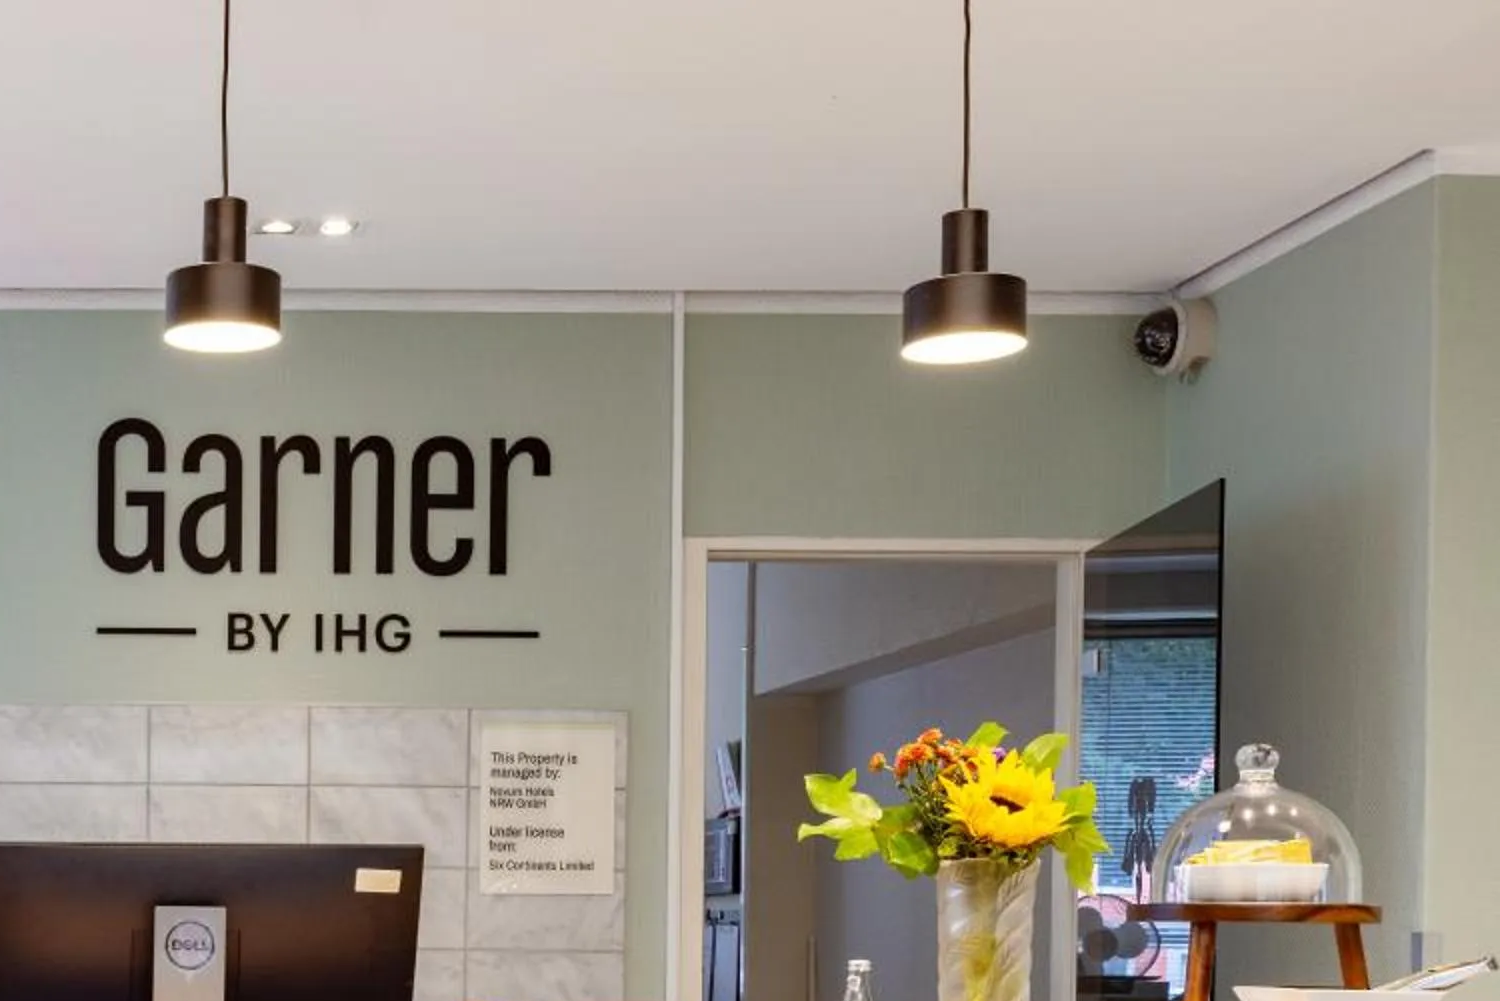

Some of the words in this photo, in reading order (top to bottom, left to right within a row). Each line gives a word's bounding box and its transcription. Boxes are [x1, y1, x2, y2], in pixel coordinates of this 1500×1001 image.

[97, 417, 552, 577] Garner
[226, 612, 291, 652] BY
[314, 612, 412, 653] IHG
[491, 751, 515, 764] This
[518, 751, 565, 767] Property
[567, 752, 578, 764] is
[490, 767, 541, 780] managed
[490, 826, 522, 838] Under
[525, 826, 565, 838] license
[489, 860, 504, 871] Six
